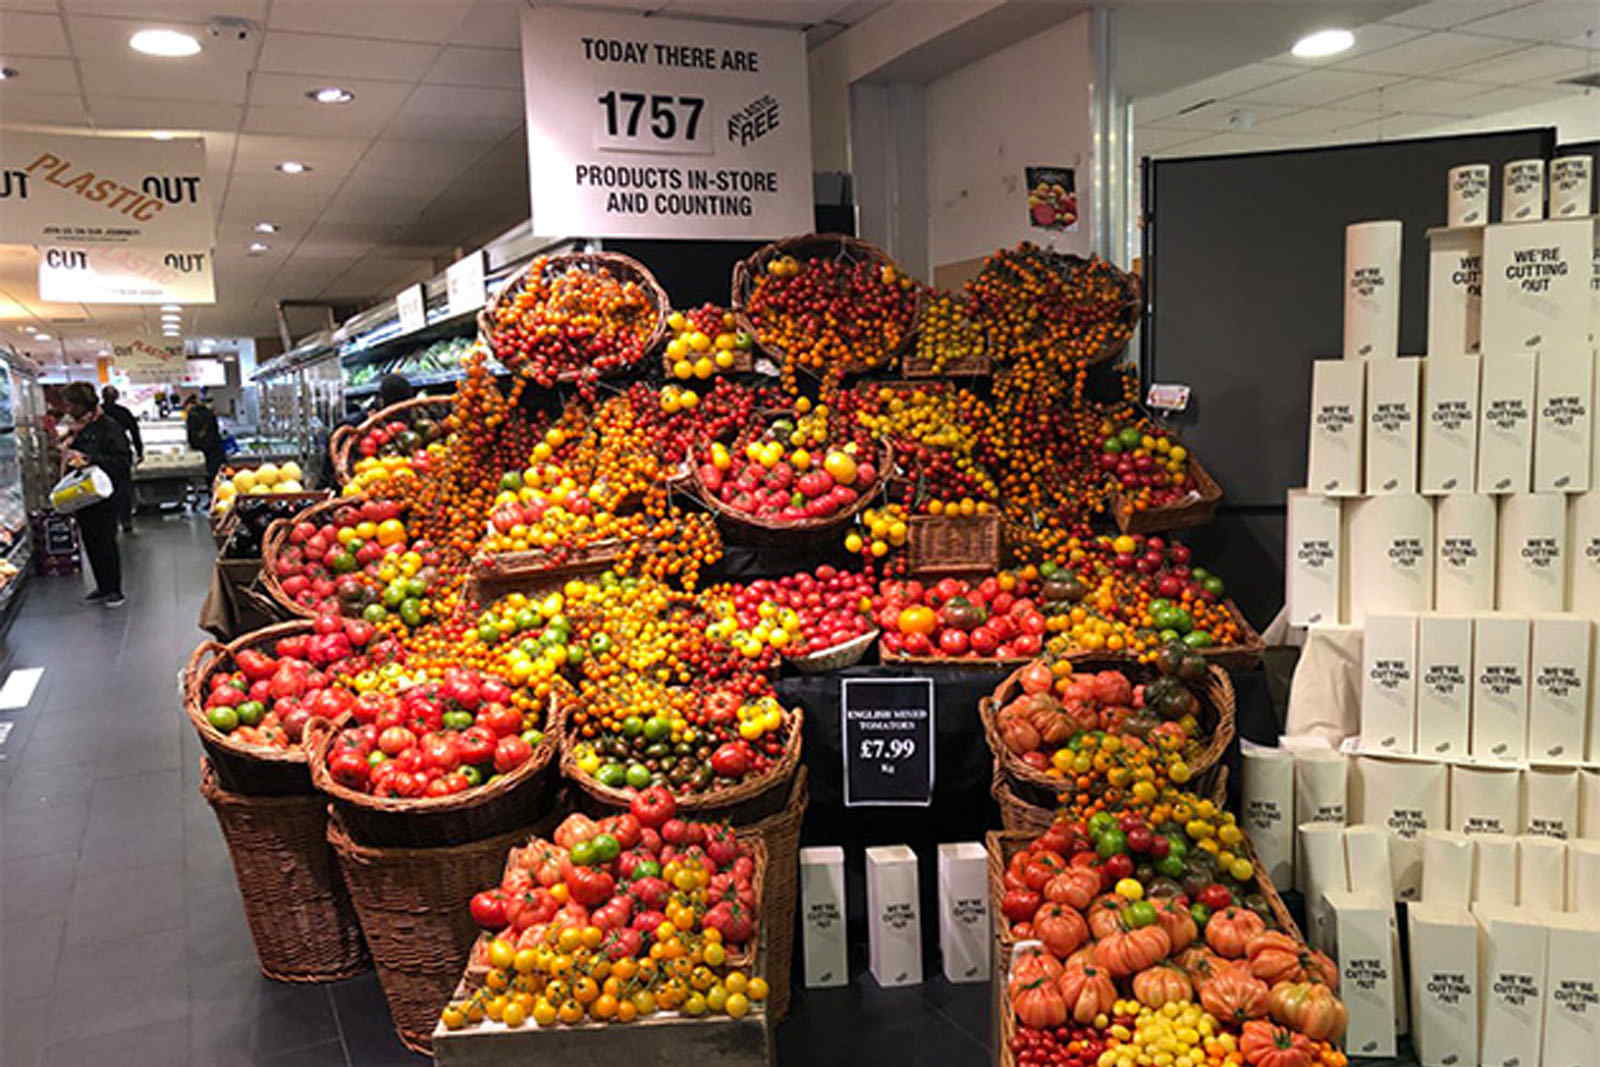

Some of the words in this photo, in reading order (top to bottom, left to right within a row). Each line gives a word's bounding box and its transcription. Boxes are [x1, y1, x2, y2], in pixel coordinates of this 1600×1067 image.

[581, 38, 648, 64] TODAY
[653, 44, 716, 69] THERE
[721, 51, 759, 72] ARE
[598, 91, 705, 141] 1757
[728, 104, 780, 147] FREE
[0, 170, 30, 199] UT
[25, 153, 164, 222] PLASTIC
[142, 176, 199, 204] OUT
[575, 165, 682, 190] PRODUCTS
[688, 171, 778, 192] IN-STORE
[606, 193, 648, 214] AND
[655, 195, 753, 216] COUNTING
[47, 248, 88, 270] CUT
[164, 253, 205, 273] OUT
[1514, 247, 1560, 263] WE'RE
[1506, 261, 1568, 280] CUTTING
[1521, 279, 1550, 293] OUT
[860, 721, 915, 731] TOMATOES
[860, 738, 915, 759] £7.99
